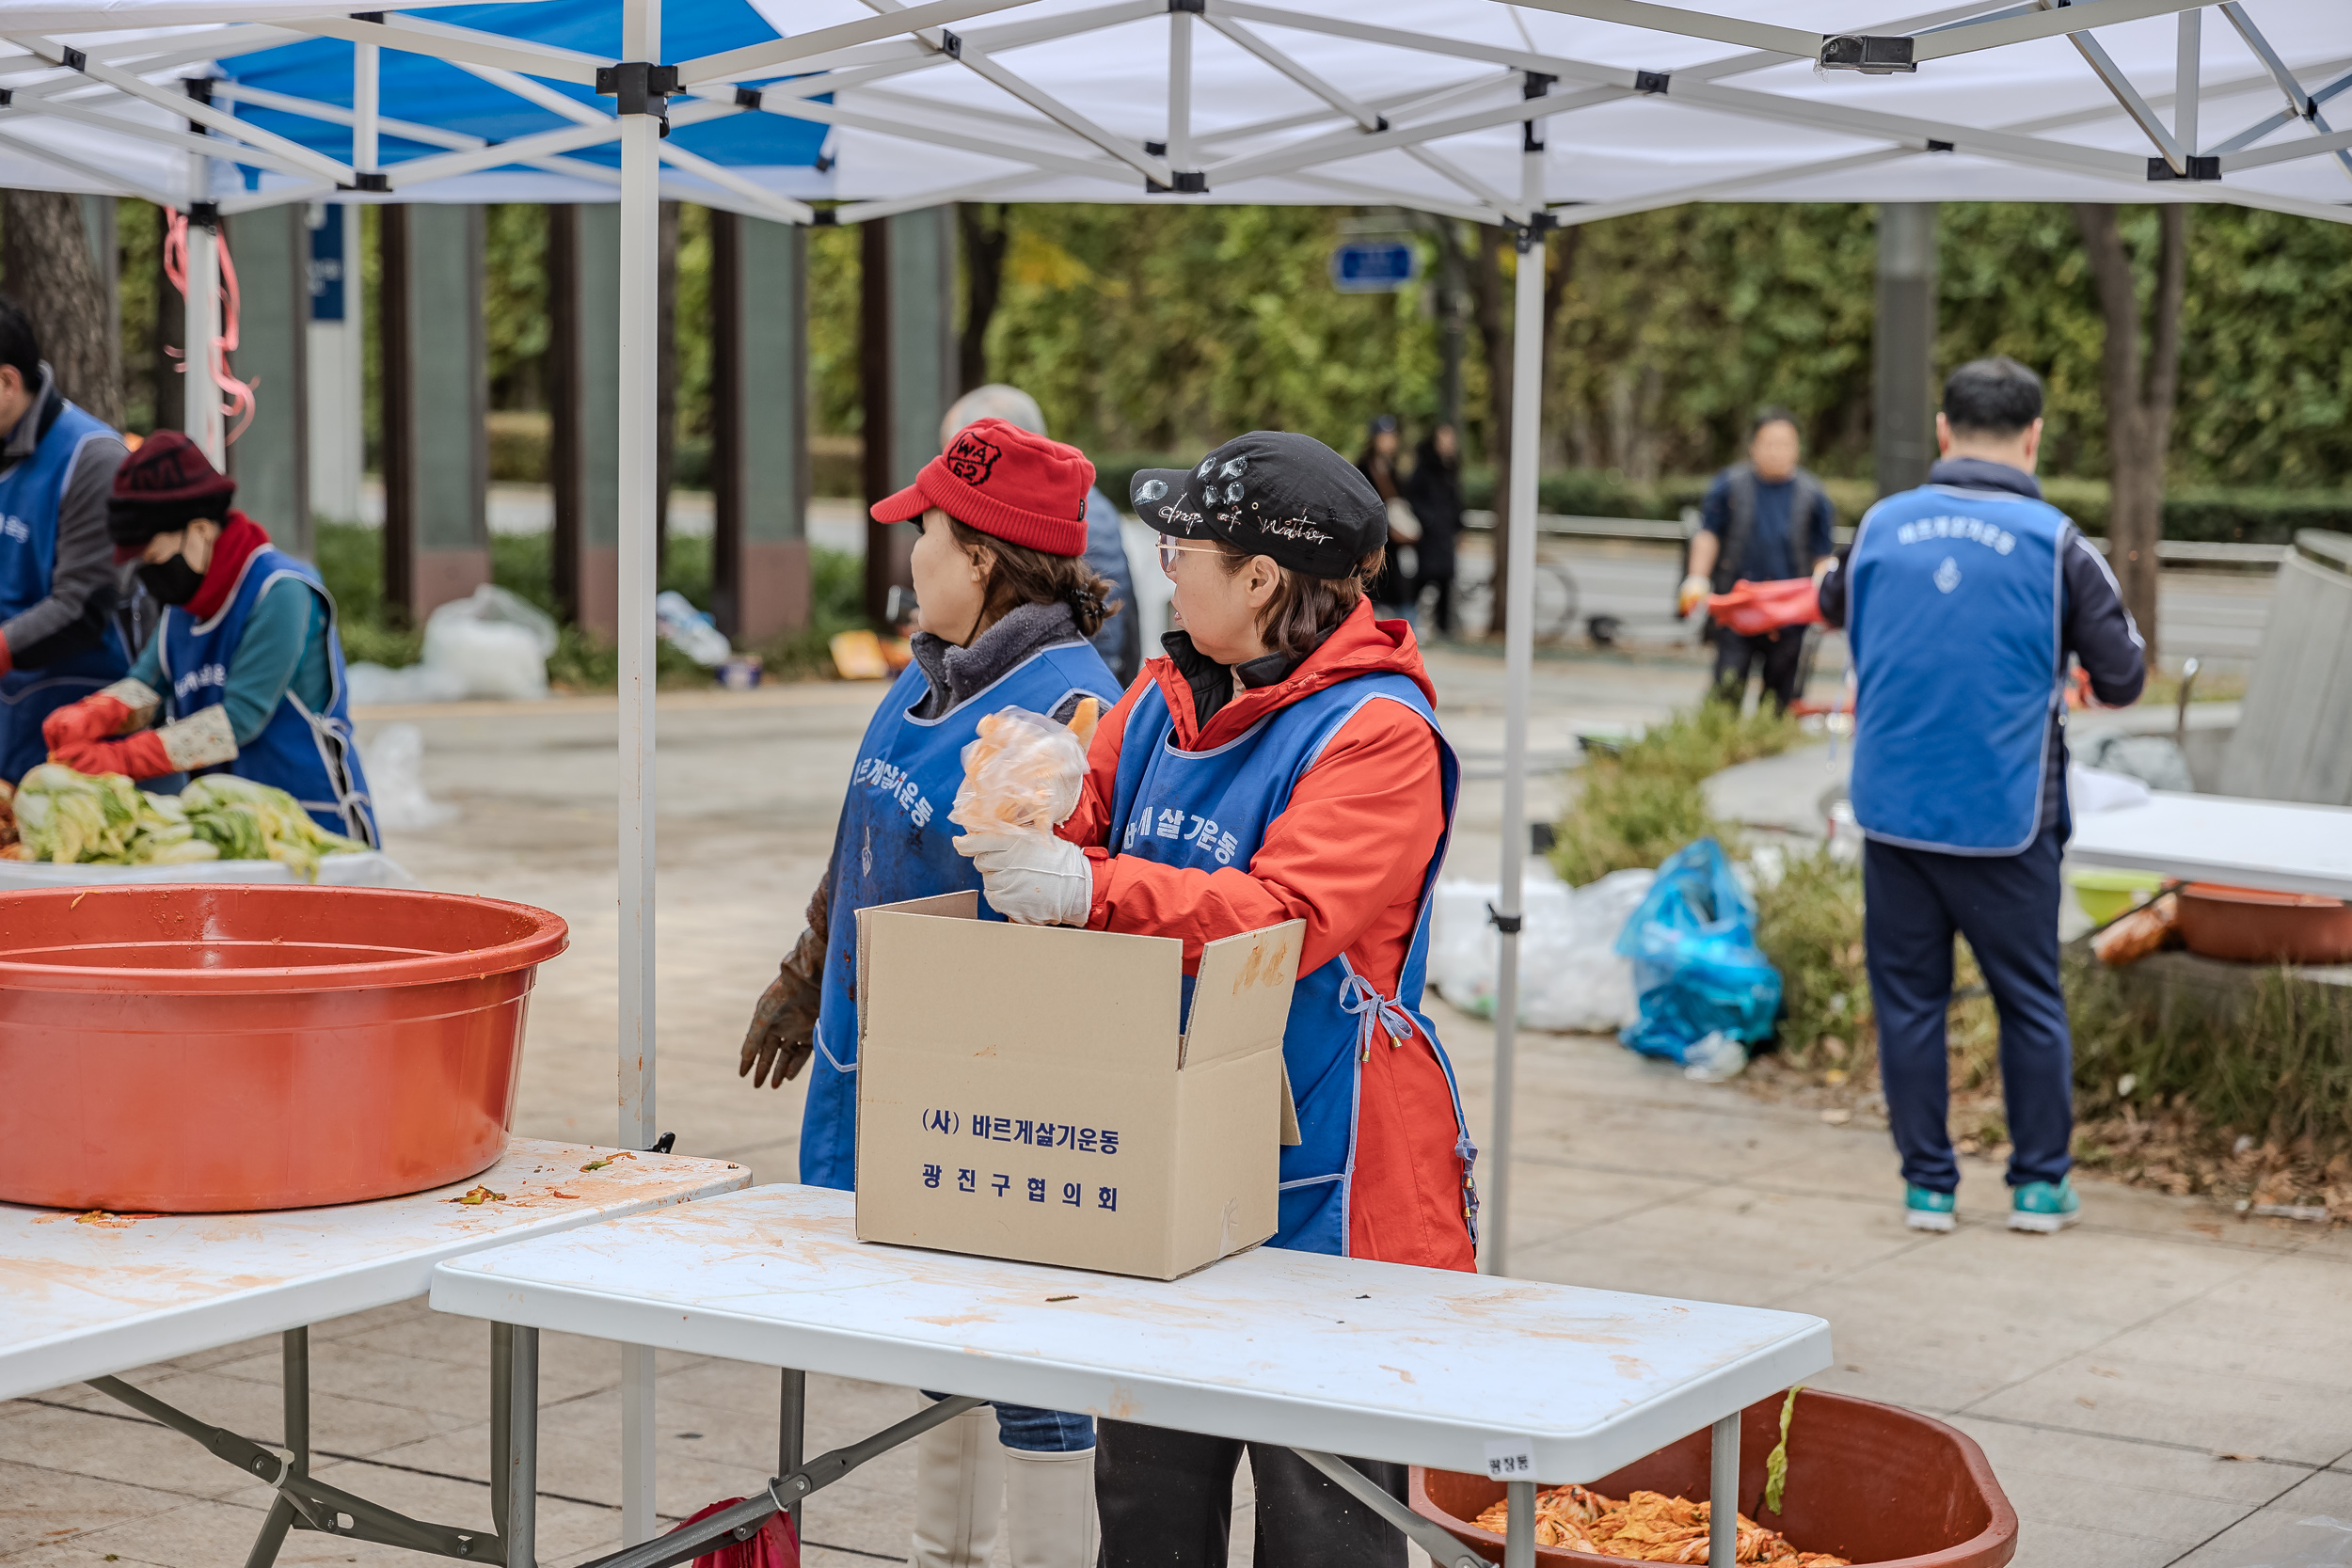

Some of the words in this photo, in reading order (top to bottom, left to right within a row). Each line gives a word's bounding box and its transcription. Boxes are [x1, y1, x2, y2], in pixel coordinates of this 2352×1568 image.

[957, 438, 987, 464] WA
[953, 462, 977, 481] 62
[922, 1108, 960, 1134] (사)
[971, 1114, 1120, 1155] 바르게살기운동
